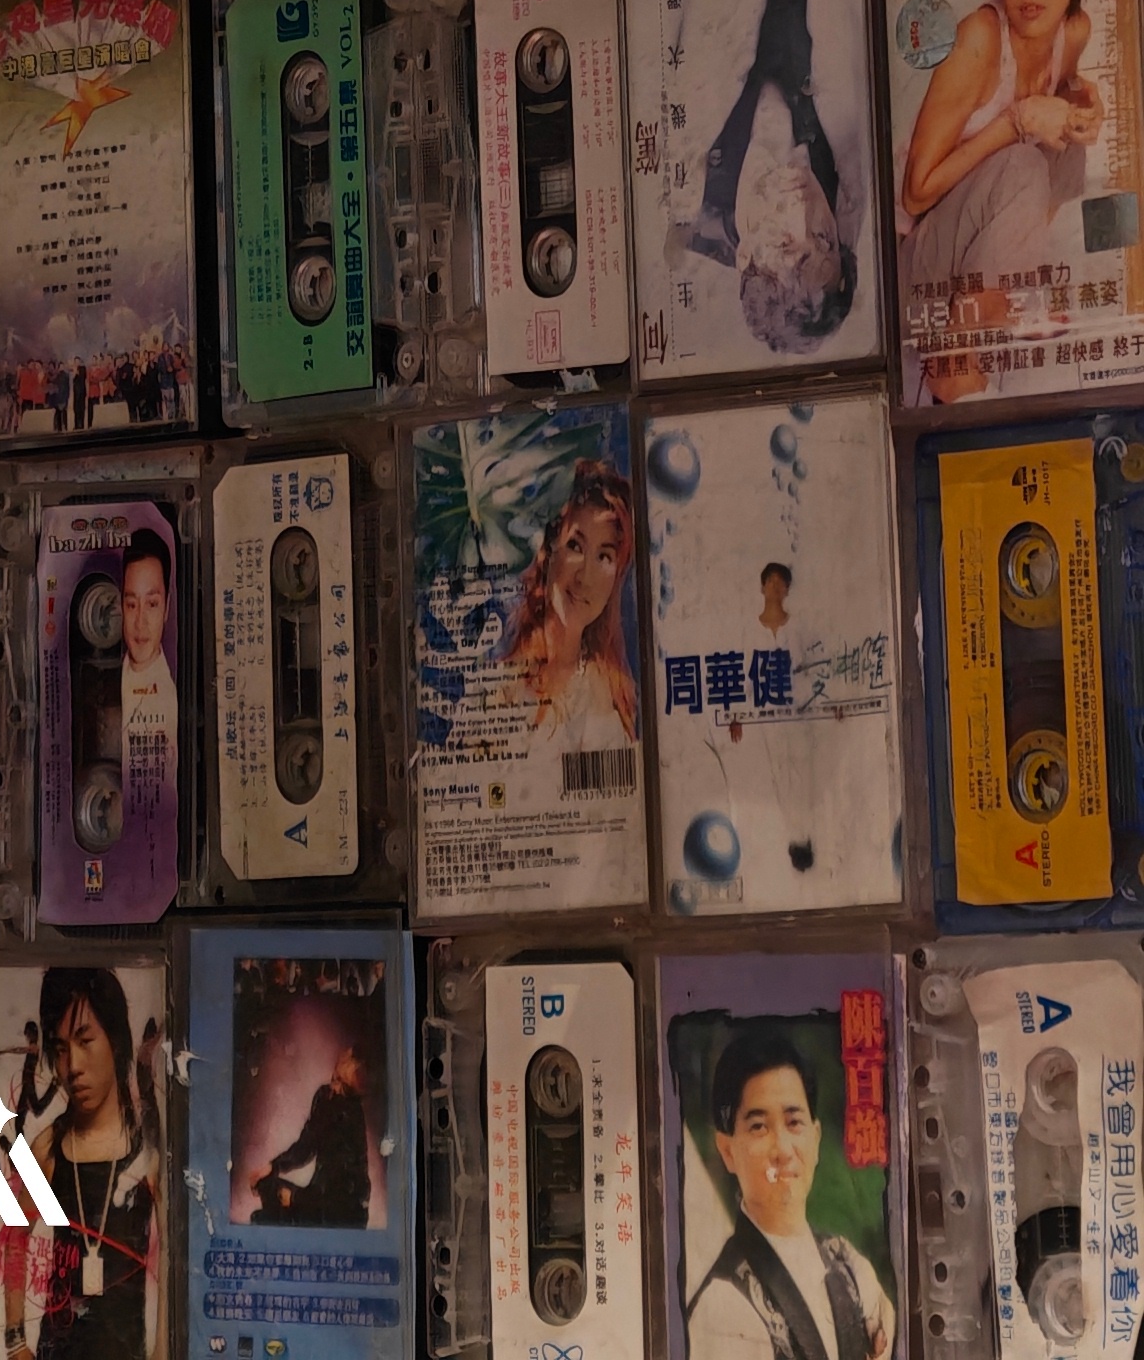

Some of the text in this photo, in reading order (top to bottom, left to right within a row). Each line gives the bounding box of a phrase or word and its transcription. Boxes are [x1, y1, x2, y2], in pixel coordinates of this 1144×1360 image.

[664, 648, 794, 716] 周華健
[283, 815, 309, 850] A
[1015, 840, 1040, 870] A
[1039, 828, 1054, 888] STEREO
[521, 975, 536, 1036] STEREO
[540, 993, 565, 1020] B
[1016, 990, 1035, 1035] STEREO
[1037, 994, 1073, 1034] A
